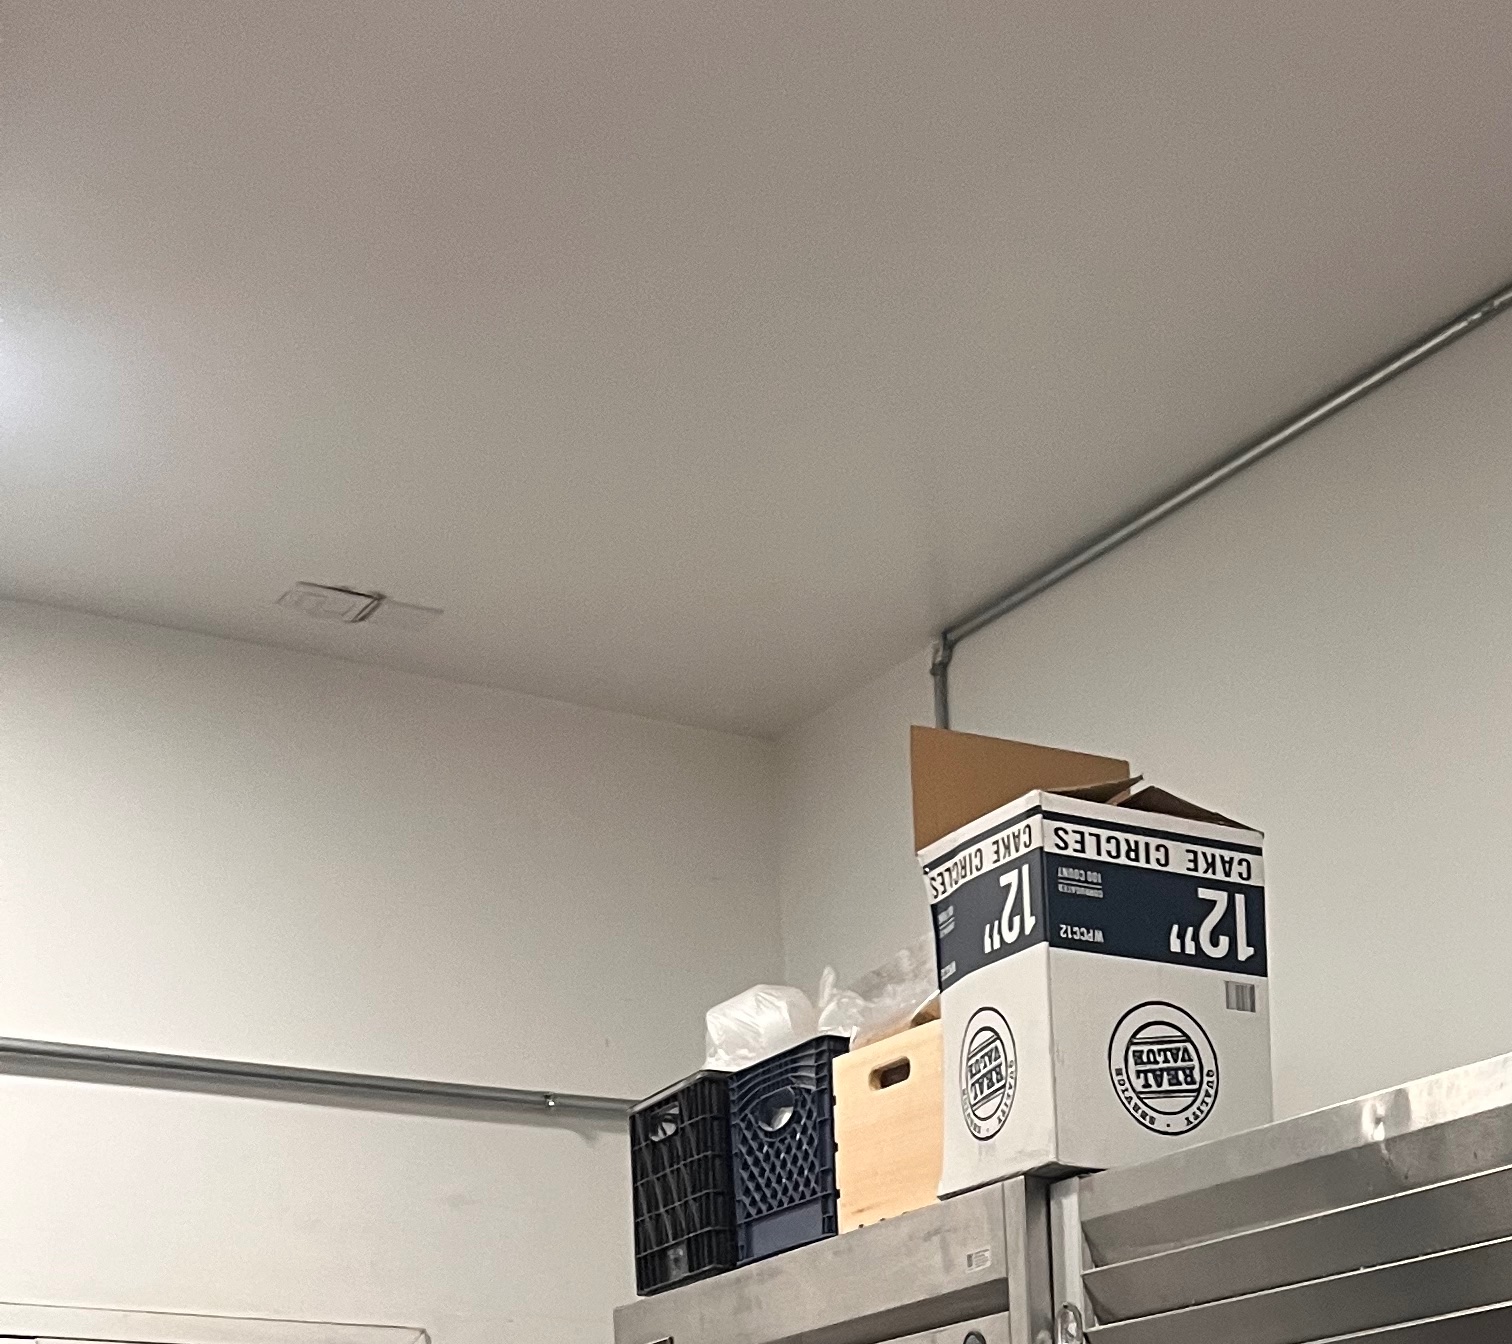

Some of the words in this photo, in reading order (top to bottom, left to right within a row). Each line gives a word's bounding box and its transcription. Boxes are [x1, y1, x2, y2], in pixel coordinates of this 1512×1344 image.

[992, 823, 1032, 864] CAKE
[1053, 826, 1171, 868] CIRCLES
[1186, 847, 1252, 881] CAKE
[930, 848, 983, 899] CIRCLES
[1132, 1044, 1194, 1066] VALUE
[970, 1061, 1004, 1102] REAL
[1134, 1066, 1198, 1089] REAL
